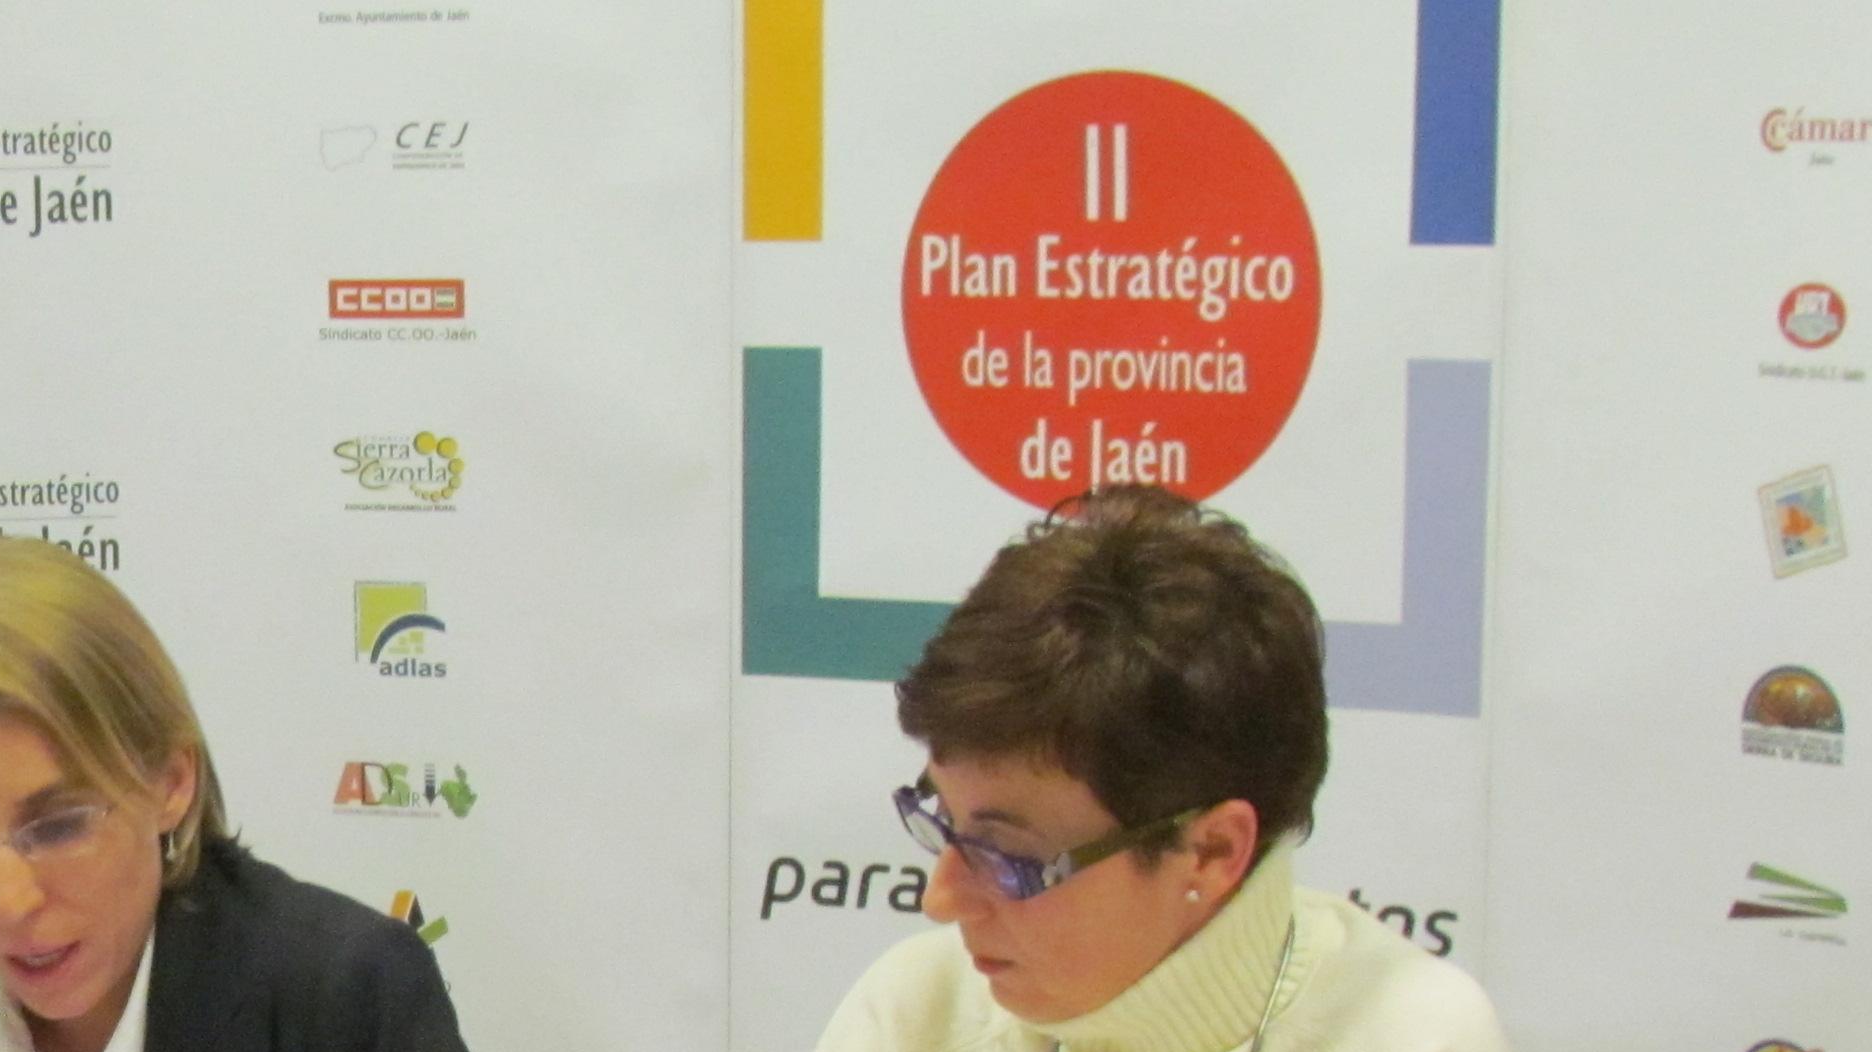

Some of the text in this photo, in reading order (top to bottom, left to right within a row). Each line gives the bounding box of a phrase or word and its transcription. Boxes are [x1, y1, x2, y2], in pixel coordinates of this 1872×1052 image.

[356, 10, 428, 25] Ayuntamiento
[430, 10, 442, 21] de
[1084, 123, 1128, 222] II
[29, 174, 112, 238] Jaén
[921, 233, 1294, 322] Plan Estratégico
[336, 287, 432, 311] CCOO
[319, 327, 382, 341] Sindicato
[962, 329, 1248, 407] de la provincia
[333, 436, 410, 473] Sierra
[358, 456, 447, 490] Cazorla
[1020, 418, 1188, 496] de Jaén
[379, 657, 447, 677] adlas
